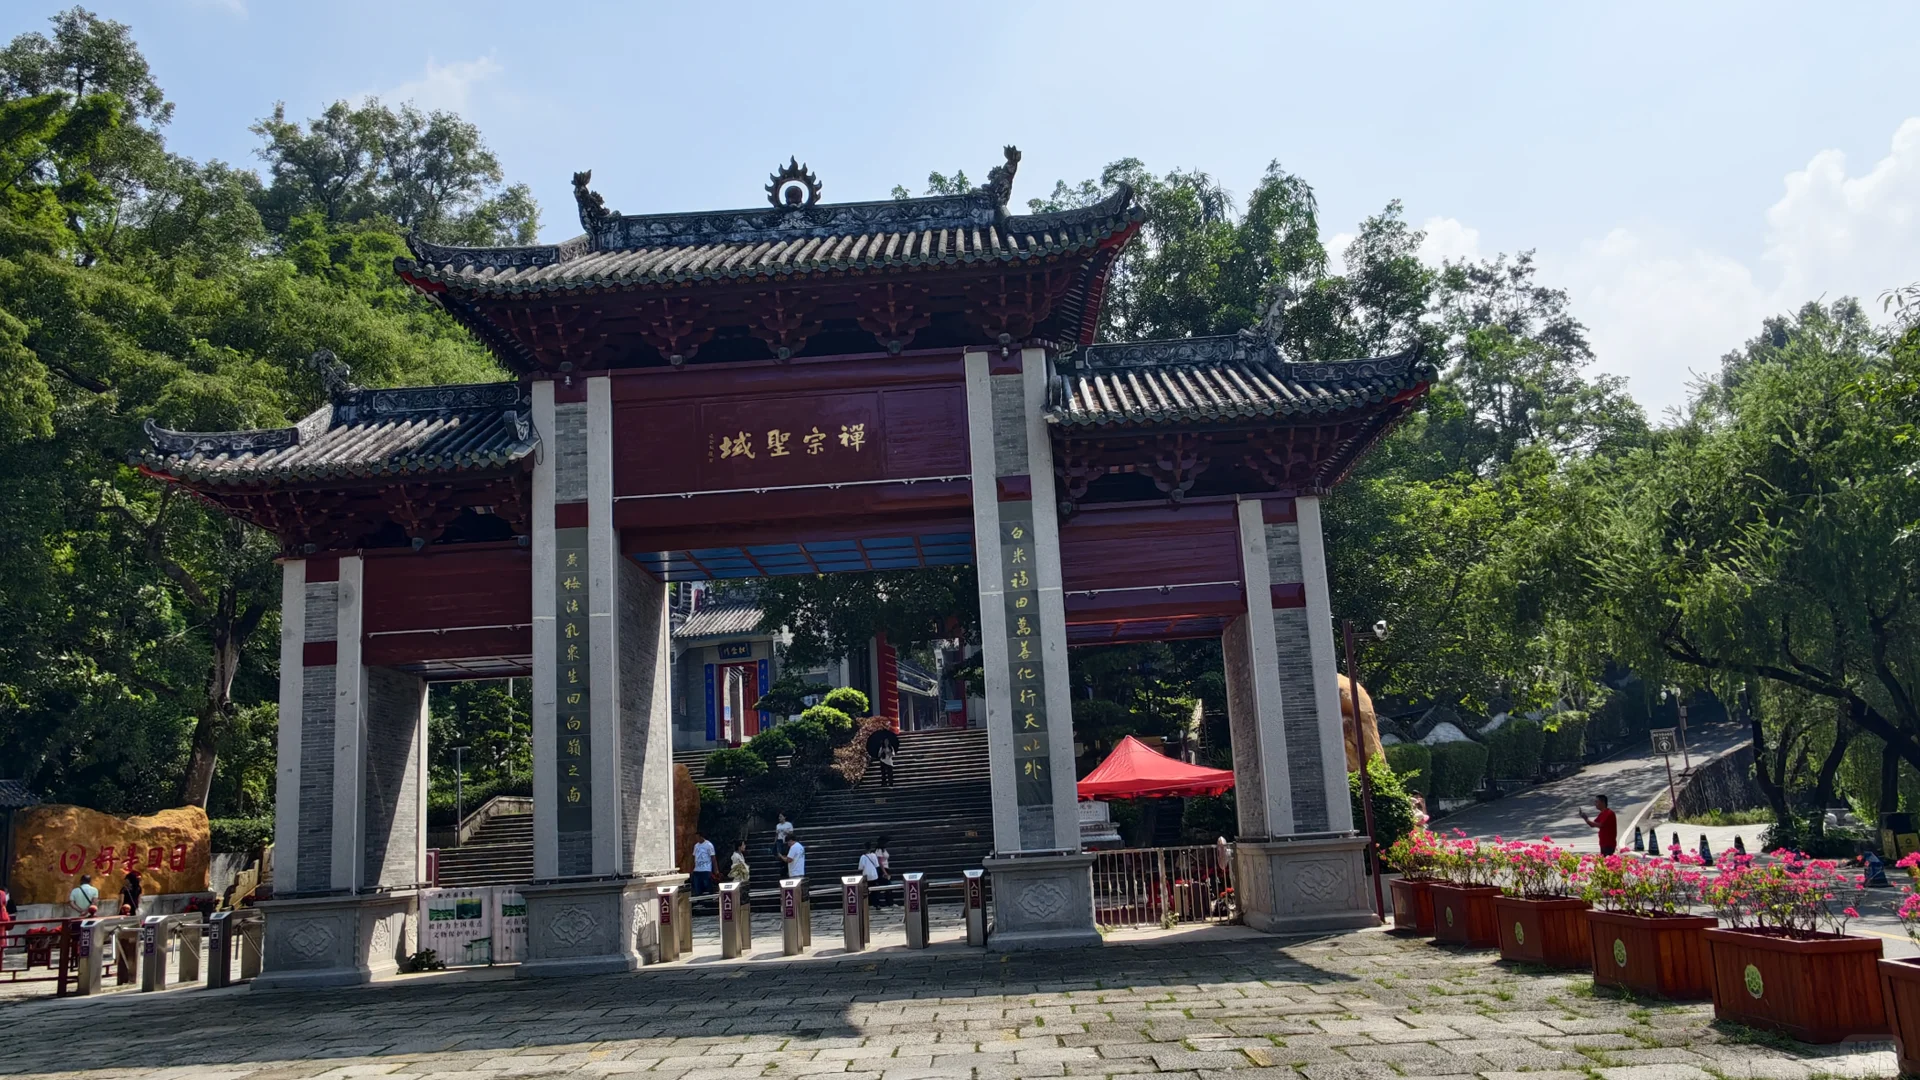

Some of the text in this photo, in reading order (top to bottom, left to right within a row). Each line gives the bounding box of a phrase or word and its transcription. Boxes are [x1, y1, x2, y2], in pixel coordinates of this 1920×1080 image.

[848, 888, 856, 904] 入口
[910, 884, 918, 900] 入口
[970, 881, 978, 897] 入口
[661, 898, 669, 914] 入口
[724, 895, 732, 910] 入口
[785, 891, 793, 907] 入口
[82, 930, 90, 947] 出口
[146, 928, 154, 944] 出口
[211, 923, 219, 940] 出口
[433, 930, 479, 939] 文物保护单位
